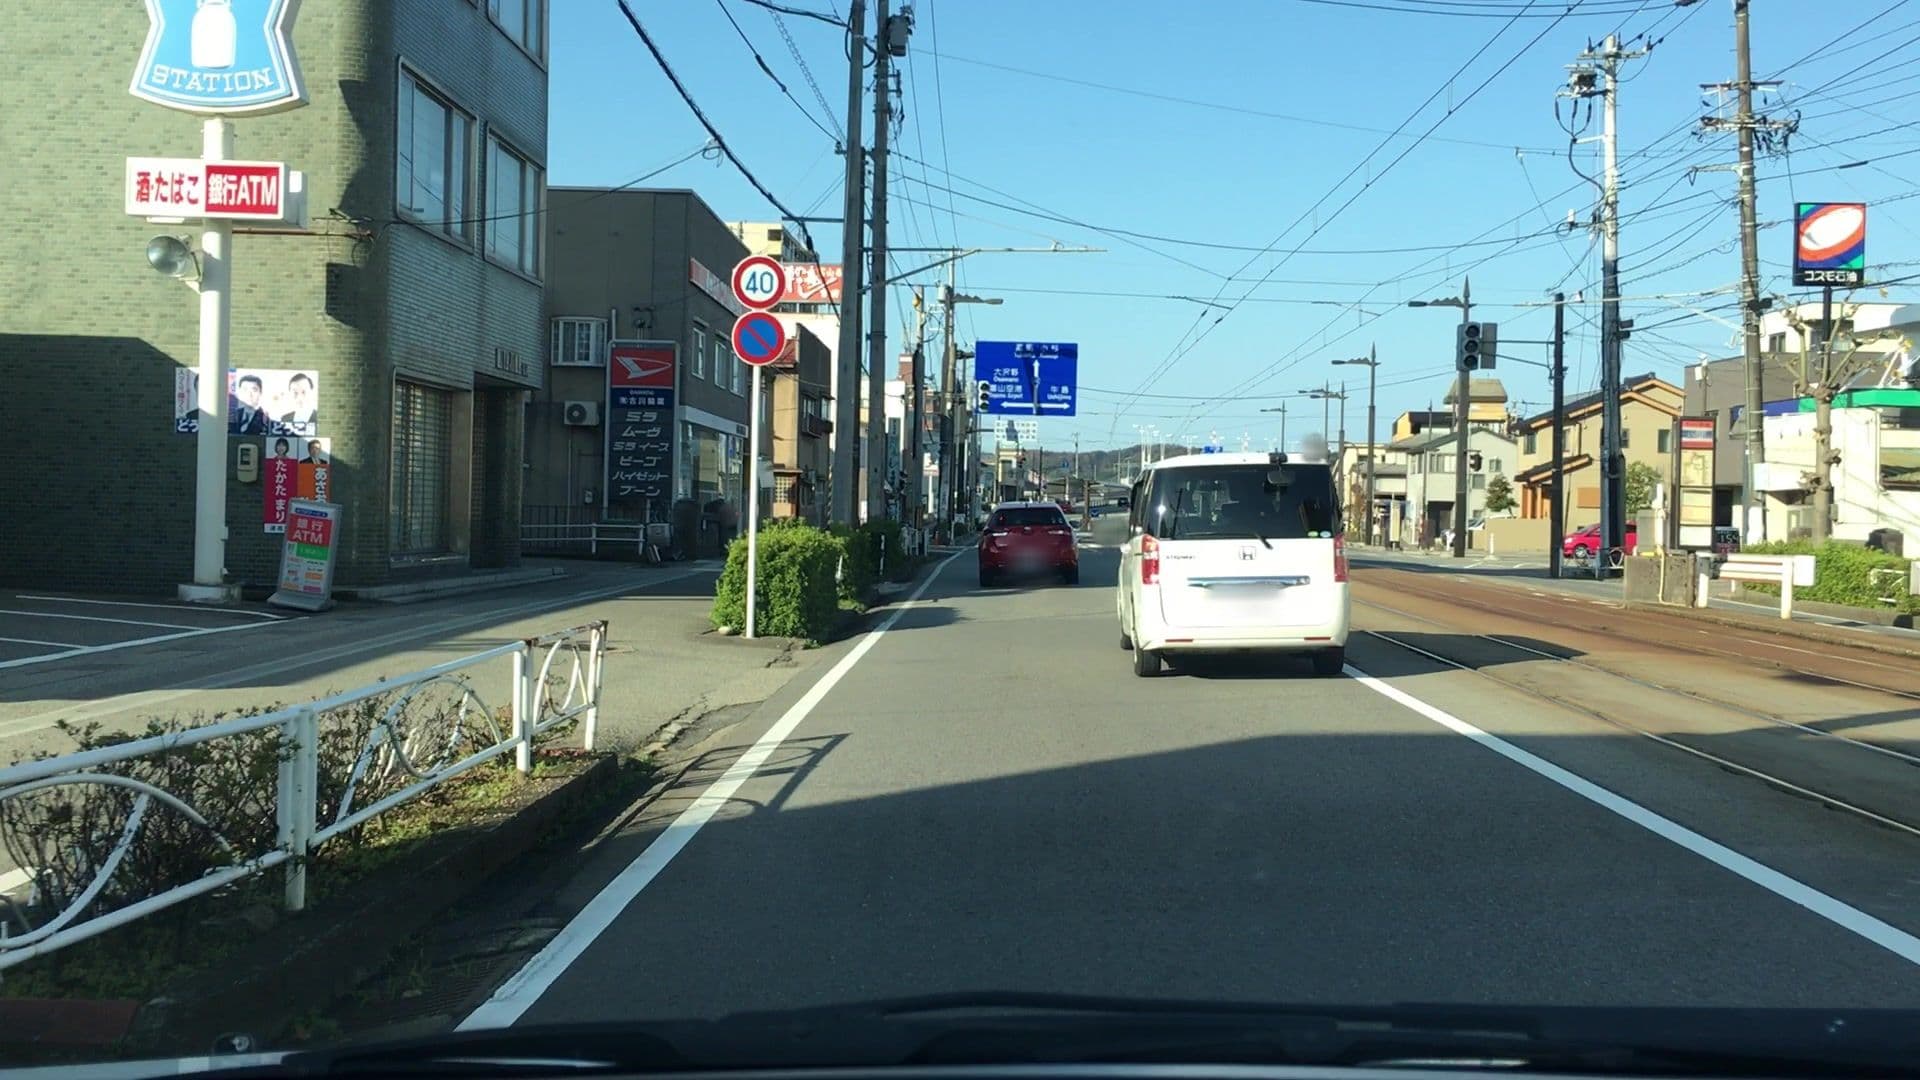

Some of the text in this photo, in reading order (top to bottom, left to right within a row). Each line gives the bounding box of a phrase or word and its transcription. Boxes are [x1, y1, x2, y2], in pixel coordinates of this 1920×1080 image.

[151, 64, 274, 92] STATION
[208, 173, 277, 206] 銀行ATM
[744, 271, 775, 294] 40
[1804, 270, 1858, 282] コスモ石油
[625, 411, 657, 422] ミラ
[621, 426, 661, 437] ムーヴ
[612, 441, 670, 452] ミラ イース
[274, 459, 288, 496] たかた
[612, 471, 670, 481] ハイゼット
[274, 500, 287, 522] まり
[296, 518, 324, 532] 銀行
[292, 530, 323, 545] ATM
